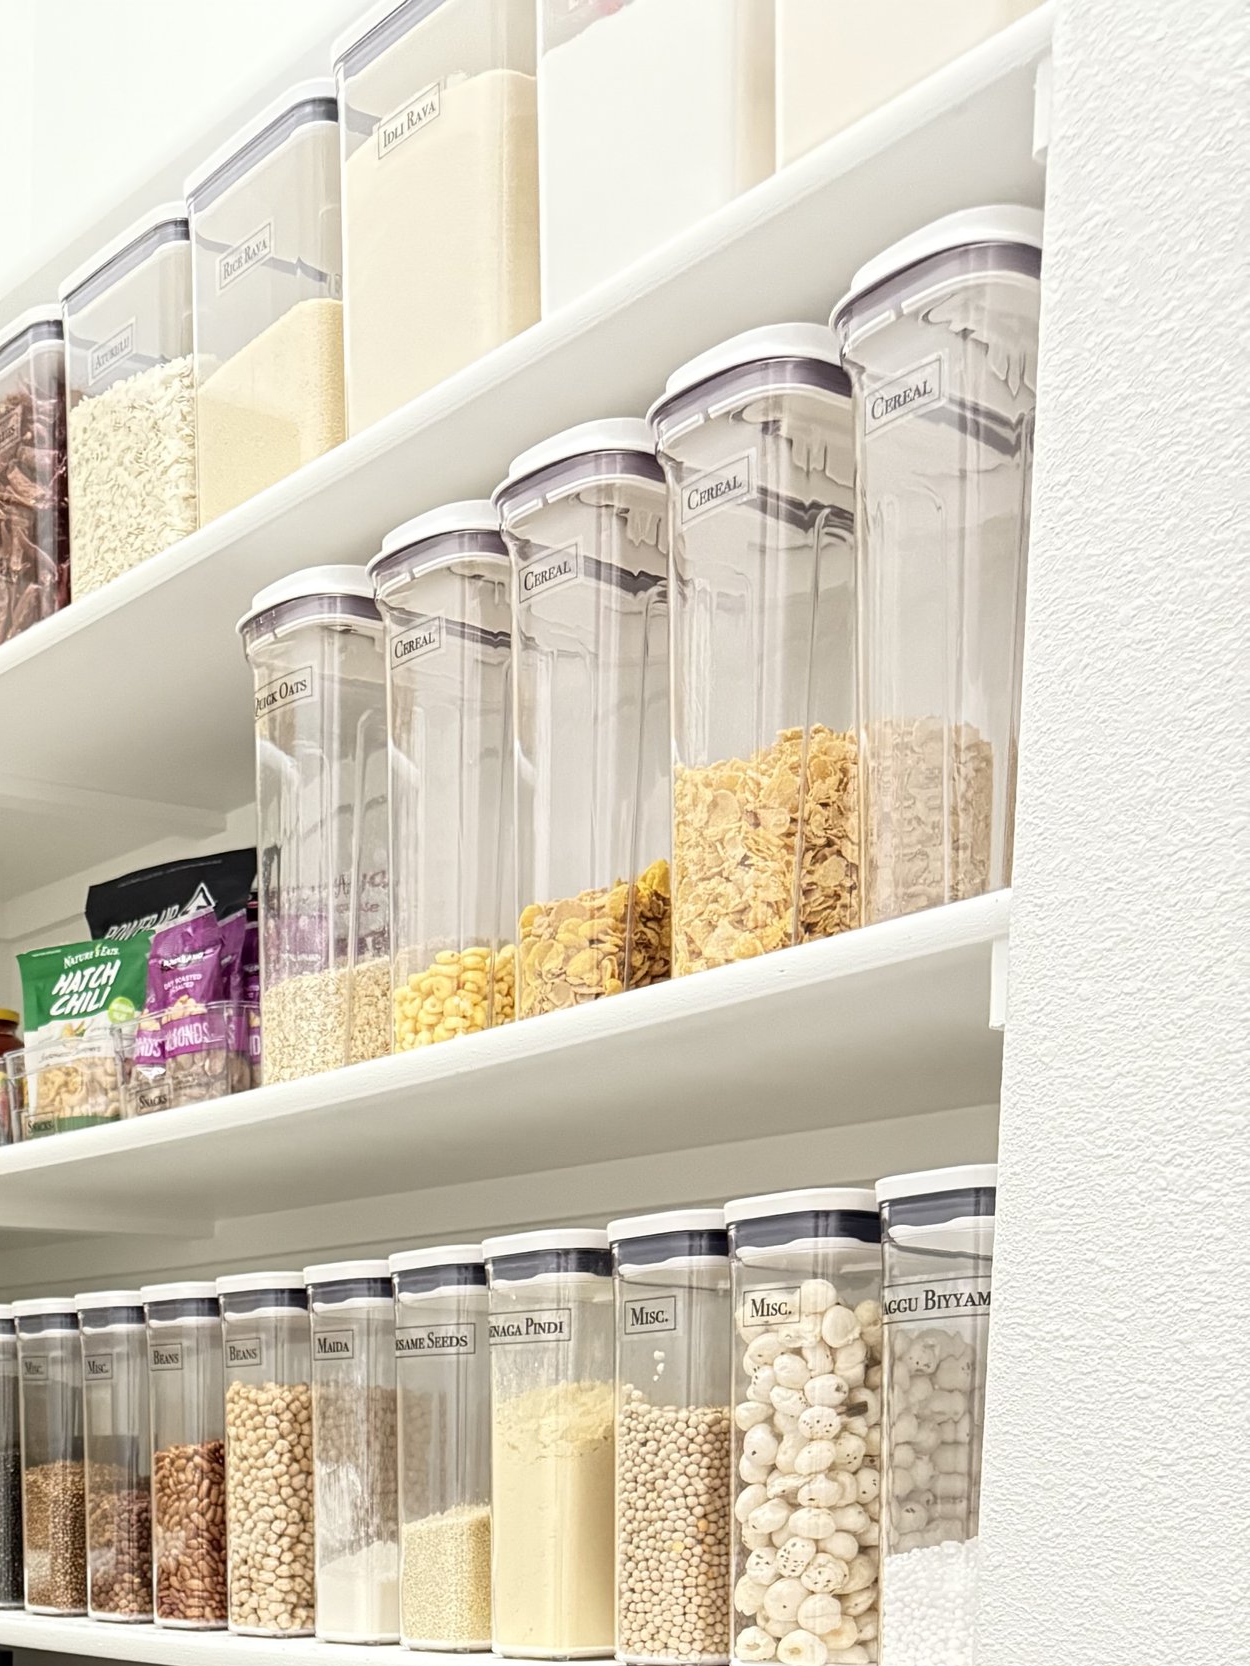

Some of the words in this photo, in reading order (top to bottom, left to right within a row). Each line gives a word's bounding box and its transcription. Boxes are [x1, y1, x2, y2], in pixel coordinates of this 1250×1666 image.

[383, 123, 404, 148] IDLI
[407, 101, 436, 131] RAVA
[223, 256, 243, 280] RICE
[244, 239, 268, 264] RAVA
[871, 380, 933, 420] CEREAL
[686, 475, 743, 511] CEREAL
[523, 560, 572, 591] CEREAL
[394, 632, 436, 660] CEREAL
[279, 678, 308, 699] OATS
[158, 904, 179, 928] UP
[52, 959, 121, 996] HATCH
[49, 986, 112, 1017] CHILI
[750, 1297, 792, 1318] MISC.
[884, 1296, 919, 1316] AGGU
[923, 1289, 992, 1311] BIYYAM
[489, 1323, 522, 1338] ENAGA
[525, 1317, 564, 1336] PINDI
[629, 1306, 669, 1326] MISC.
[229, 1346, 257, 1360] BEANS
[317, 1338, 350, 1354] MAIDA
[395, 1337, 425, 1351] ESAME
[426, 1332, 468, 1349] SEEDS
[87, 1359, 110, 1374] MISC.
[153, 1350, 179, 1364] BEANS
